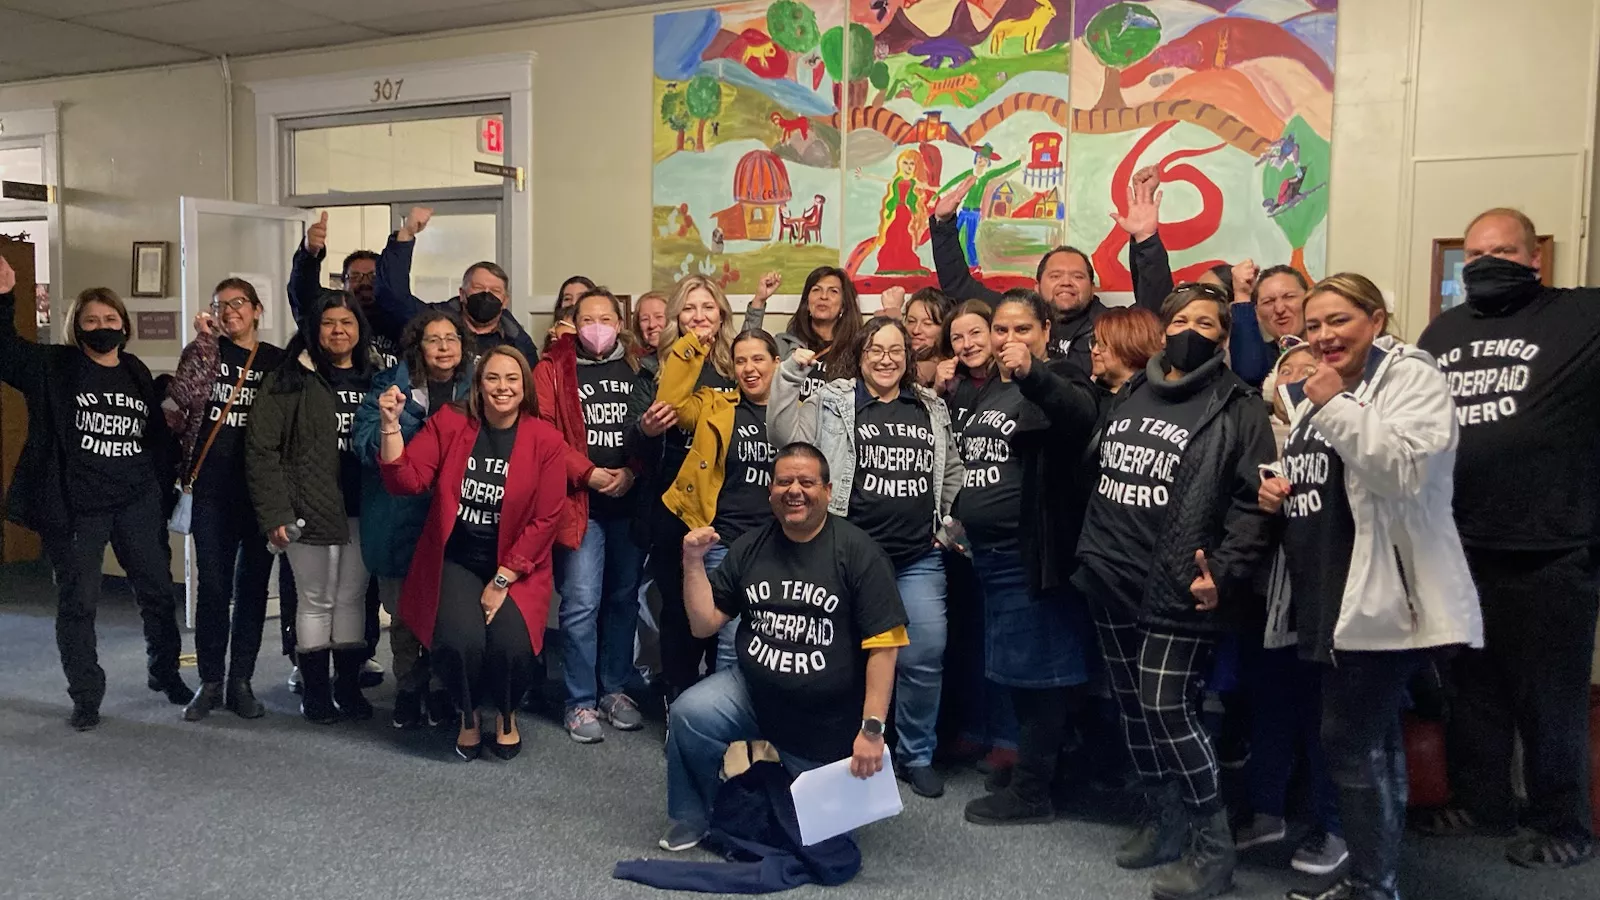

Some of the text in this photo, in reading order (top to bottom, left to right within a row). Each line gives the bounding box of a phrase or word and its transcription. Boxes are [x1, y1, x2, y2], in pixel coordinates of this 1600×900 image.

[369, 78, 405, 102] 307
[1437, 339, 1539, 368] NO TENGO
[76, 392, 99, 407] NO
[577, 383, 595, 402] NO
[210, 406, 248, 428] DNE
[581, 402, 628, 425] NDERP
[978, 410, 1017, 435] TENGO
[1455, 396, 1517, 427] NERO
[75, 410, 146, 438] UNDERPA
[737, 424, 760, 438] NO
[858, 423, 880, 440] NO
[884, 423, 935, 446] TENGO
[1107, 418, 1131, 436] NO
[81, 434, 143, 457] DINERO
[587, 429, 624, 448] DINE
[738, 441, 780, 463] UNDE
[859, 444, 934, 473] UNDERPAID
[1100, 440, 1181, 483] UNDERPAID
[485, 457, 510, 478] TEN
[863, 473, 928, 498] DINERO
[1098, 474, 1169, 508] DINERO
[746, 580, 840, 613] NO TENGO
[749, 609, 834, 646] UNDERPAID
[748, 635, 827, 674] DINERO
